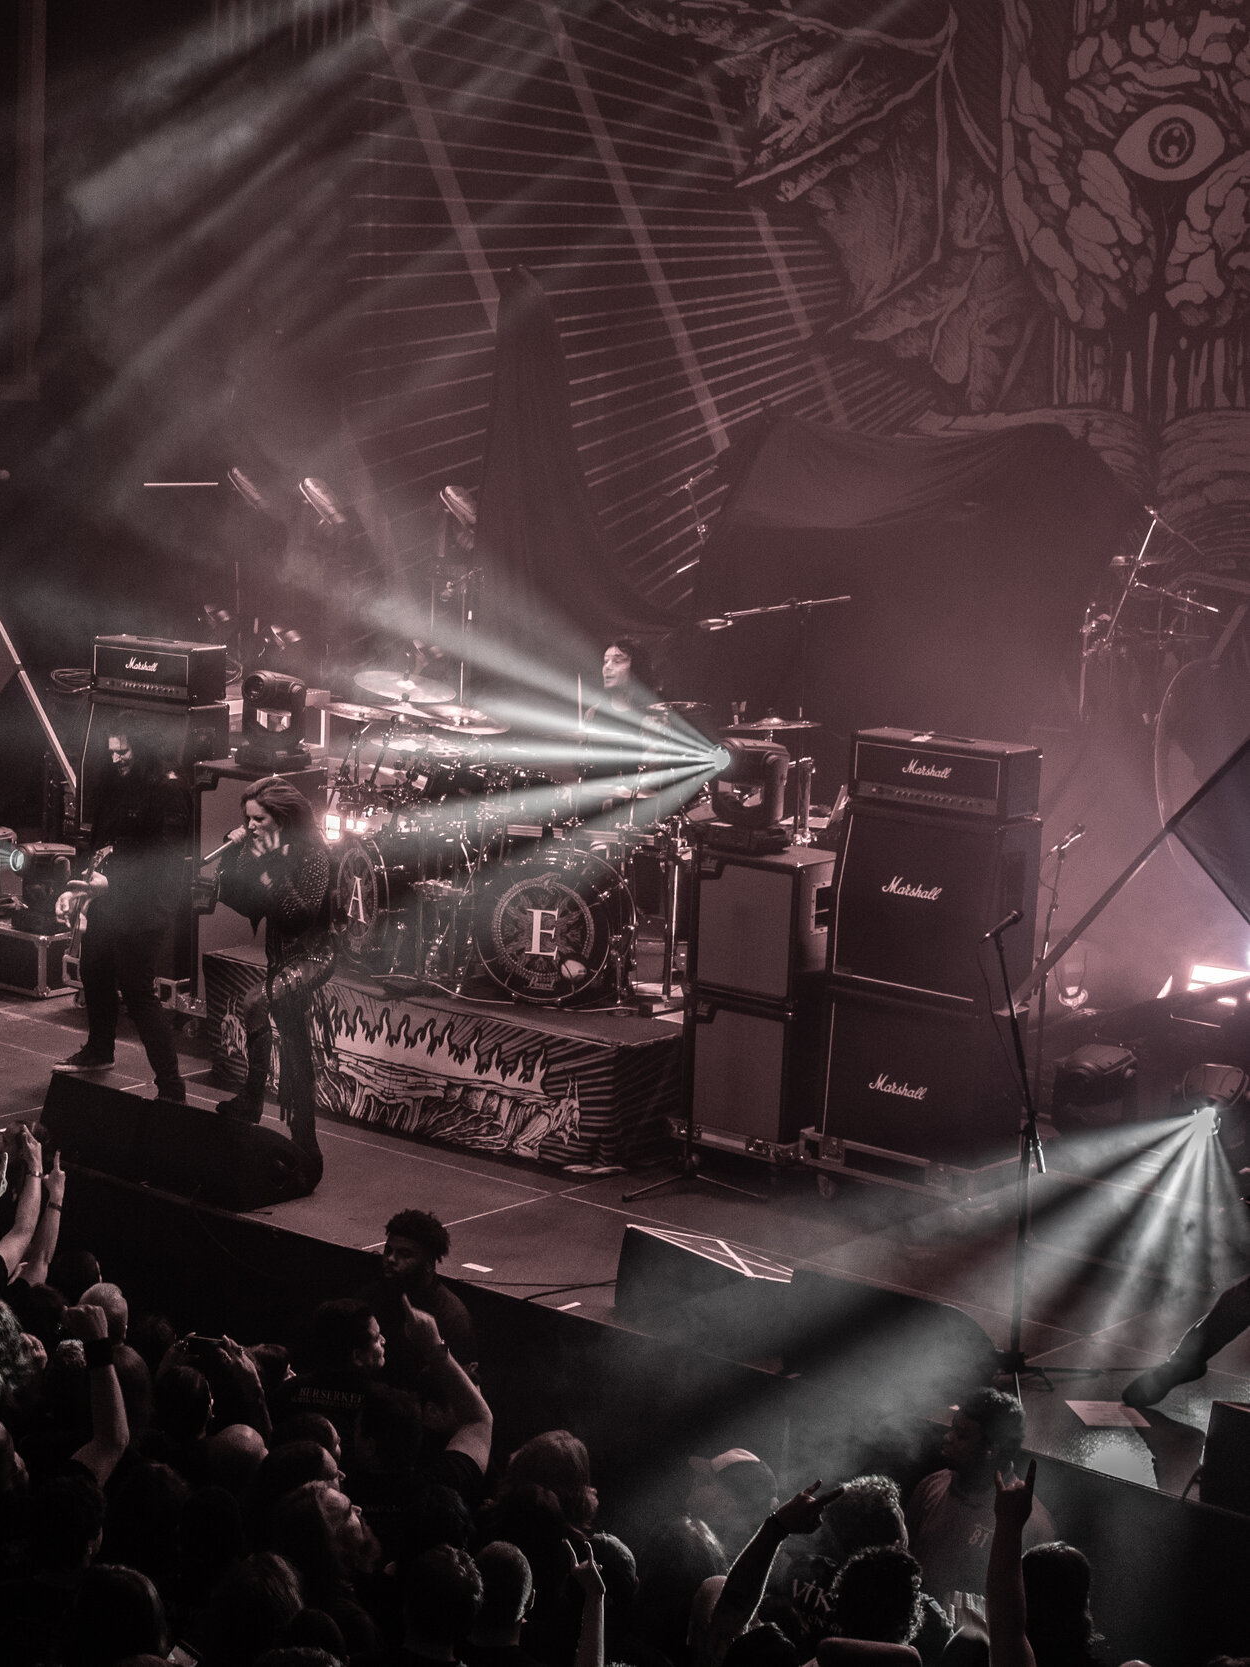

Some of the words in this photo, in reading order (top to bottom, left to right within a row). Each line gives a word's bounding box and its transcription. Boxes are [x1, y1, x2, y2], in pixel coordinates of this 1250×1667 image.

[125, 656, 159, 672] Marshall
[901, 758, 953, 779] Marshall
[347, 875, 367, 924] A
[881, 875, 943, 901] Marshall
[525, 908, 560, 960] E
[868, 1073, 928, 1100] Marshall
